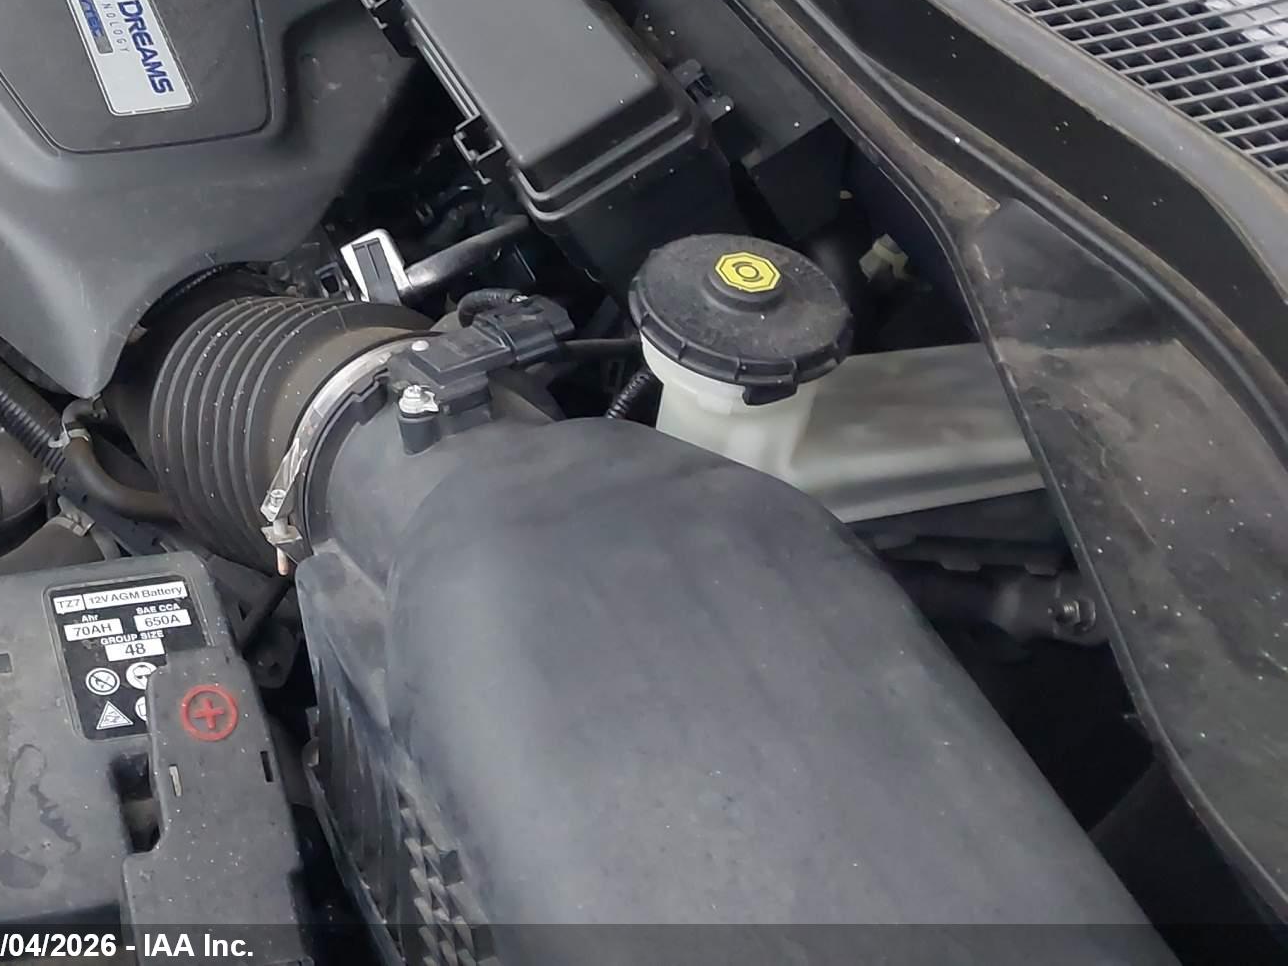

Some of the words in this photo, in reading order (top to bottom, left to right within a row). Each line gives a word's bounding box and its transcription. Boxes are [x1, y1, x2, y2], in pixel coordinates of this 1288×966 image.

[117, 0, 174, 94] DREAMS
[57, 598, 80, 609] TZ7
[89, 594, 108, 605] 12V
[111, 591, 140, 602] AGM
[141, 586, 182, 597] Battery
[136, 605, 157, 615] SAE
[158, 602, 180, 612] CCA
[145, 614, 181, 627] 650A
[72, 623, 112, 637] 70AH
[100, 634, 138, 646] GROUP
[140, 630, 165, 640] SIZE
[125, 643, 146, 656] 48
